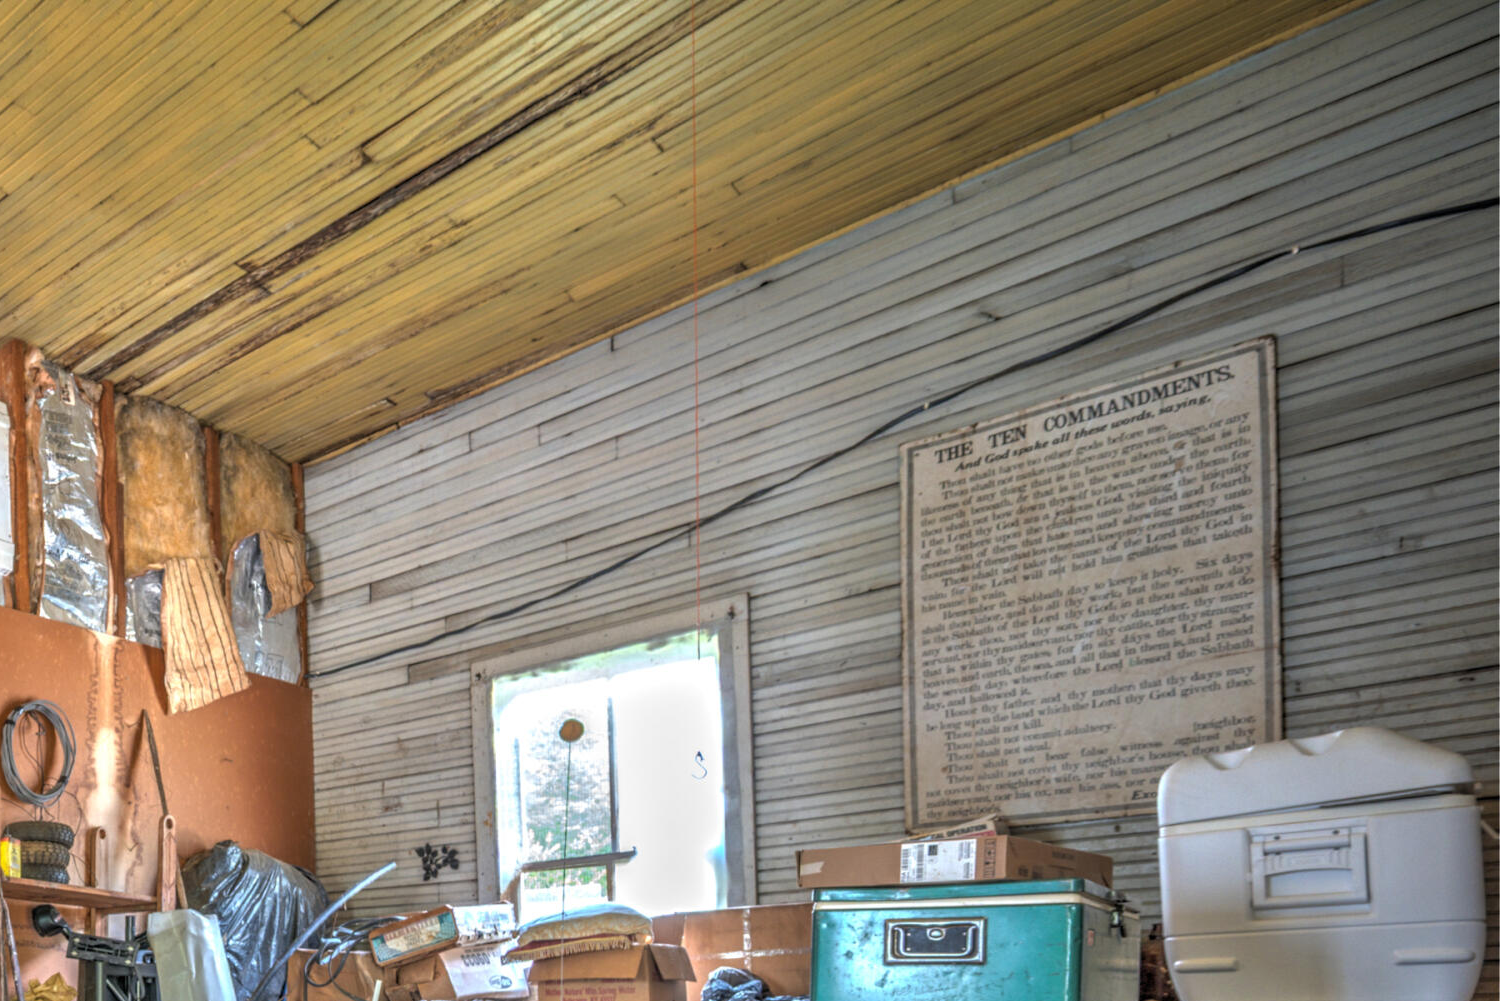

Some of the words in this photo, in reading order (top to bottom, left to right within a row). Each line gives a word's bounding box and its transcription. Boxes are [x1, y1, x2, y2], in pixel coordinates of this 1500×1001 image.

[934, 440, 973, 464] THE
[988, 424, 1026, 449] TEN
[1043, 364, 1235, 431] COMMANDMENTS.
[939, 475, 965, 490] Thou
[969, 467, 995, 482] shalt
[999, 460, 1023, 474] have
[1027, 457, 1040, 466] no
[1044, 446, 1071, 462] other
[1076, 438, 1103, 456] gods
[1107, 427, 1143, 445] before
[1147, 422, 1167, 434] me.
[954, 456, 981, 472] And
[984, 448, 1009, 464] God
[1012, 438, 1048, 457] spake
[1052, 431, 1070, 445] all
[1074, 421, 1107, 439] these
[1110, 407, 1155, 429] words,
[926, 722, 936, 731] be
[940, 719, 961, 731] long
[964, 715, 989, 728] upon
[993, 712, 1008, 722] the
[1011, 709, 1033, 719] land
[1037, 703, 1071, 715] which
[1072, 700, 1088, 711] the
[1092, 696, 1120, 708] Lord
[1125, 692, 1145, 705] thy
[1149, 687, 1175, 700] God
[1180, 681, 1220, 697] giveth
[945, 705, 977, 718] Honor
[981, 702, 997, 715] thy
[1003, 696, 1034, 709] father
[1041, 693, 1060, 704] and
[1067, 689, 1087, 701] thy
[1139, 677, 1161, 689] that
[1166, 673, 1187, 687] thy
[1190, 668, 1221, 684] days
[1226, 665, 1254, 679] may
[945, 728, 972, 740] Thou
[974, 725, 999, 736] shalt
[1003, 723, 1018, 732] not
[1023, 718, 1043, 729] kill.
[945, 740, 973, 751] Thou
[975, 736, 1000, 747] shalt
[1004, 734, 1019, 743] not
[1023, 728, 1061, 740] commit
[1064, 721, 1116, 734] adultery.
[946, 751, 973, 762] Thou
[976, 747, 1000, 758] shalt
[1003, 746, 1019, 755] not
[1023, 741, 1050, 752] steal.
[947, 762, 972, 773] Thou
[982, 758, 1007, 769] shalt
[1018, 755, 1034, 764] not
[1045, 750, 1069, 761] bear
[1081, 745, 1107, 757] false
[1120, 739, 1162, 752] witness
[1173, 732, 1219, 747] against
[1233, 727, 1255, 740] thy
[946, 773, 973, 784] Thou
[978, 770, 1003, 780] shalt
[1007, 768, 1024, 777] not
[1028, 764, 1056, 775] covet
[1061, 761, 1077, 772] thy
[1085, 752, 1144, 769] neighbor's
[1191, 743, 1219, 755] thou
[948, 823, 988, 838] OPERATION
